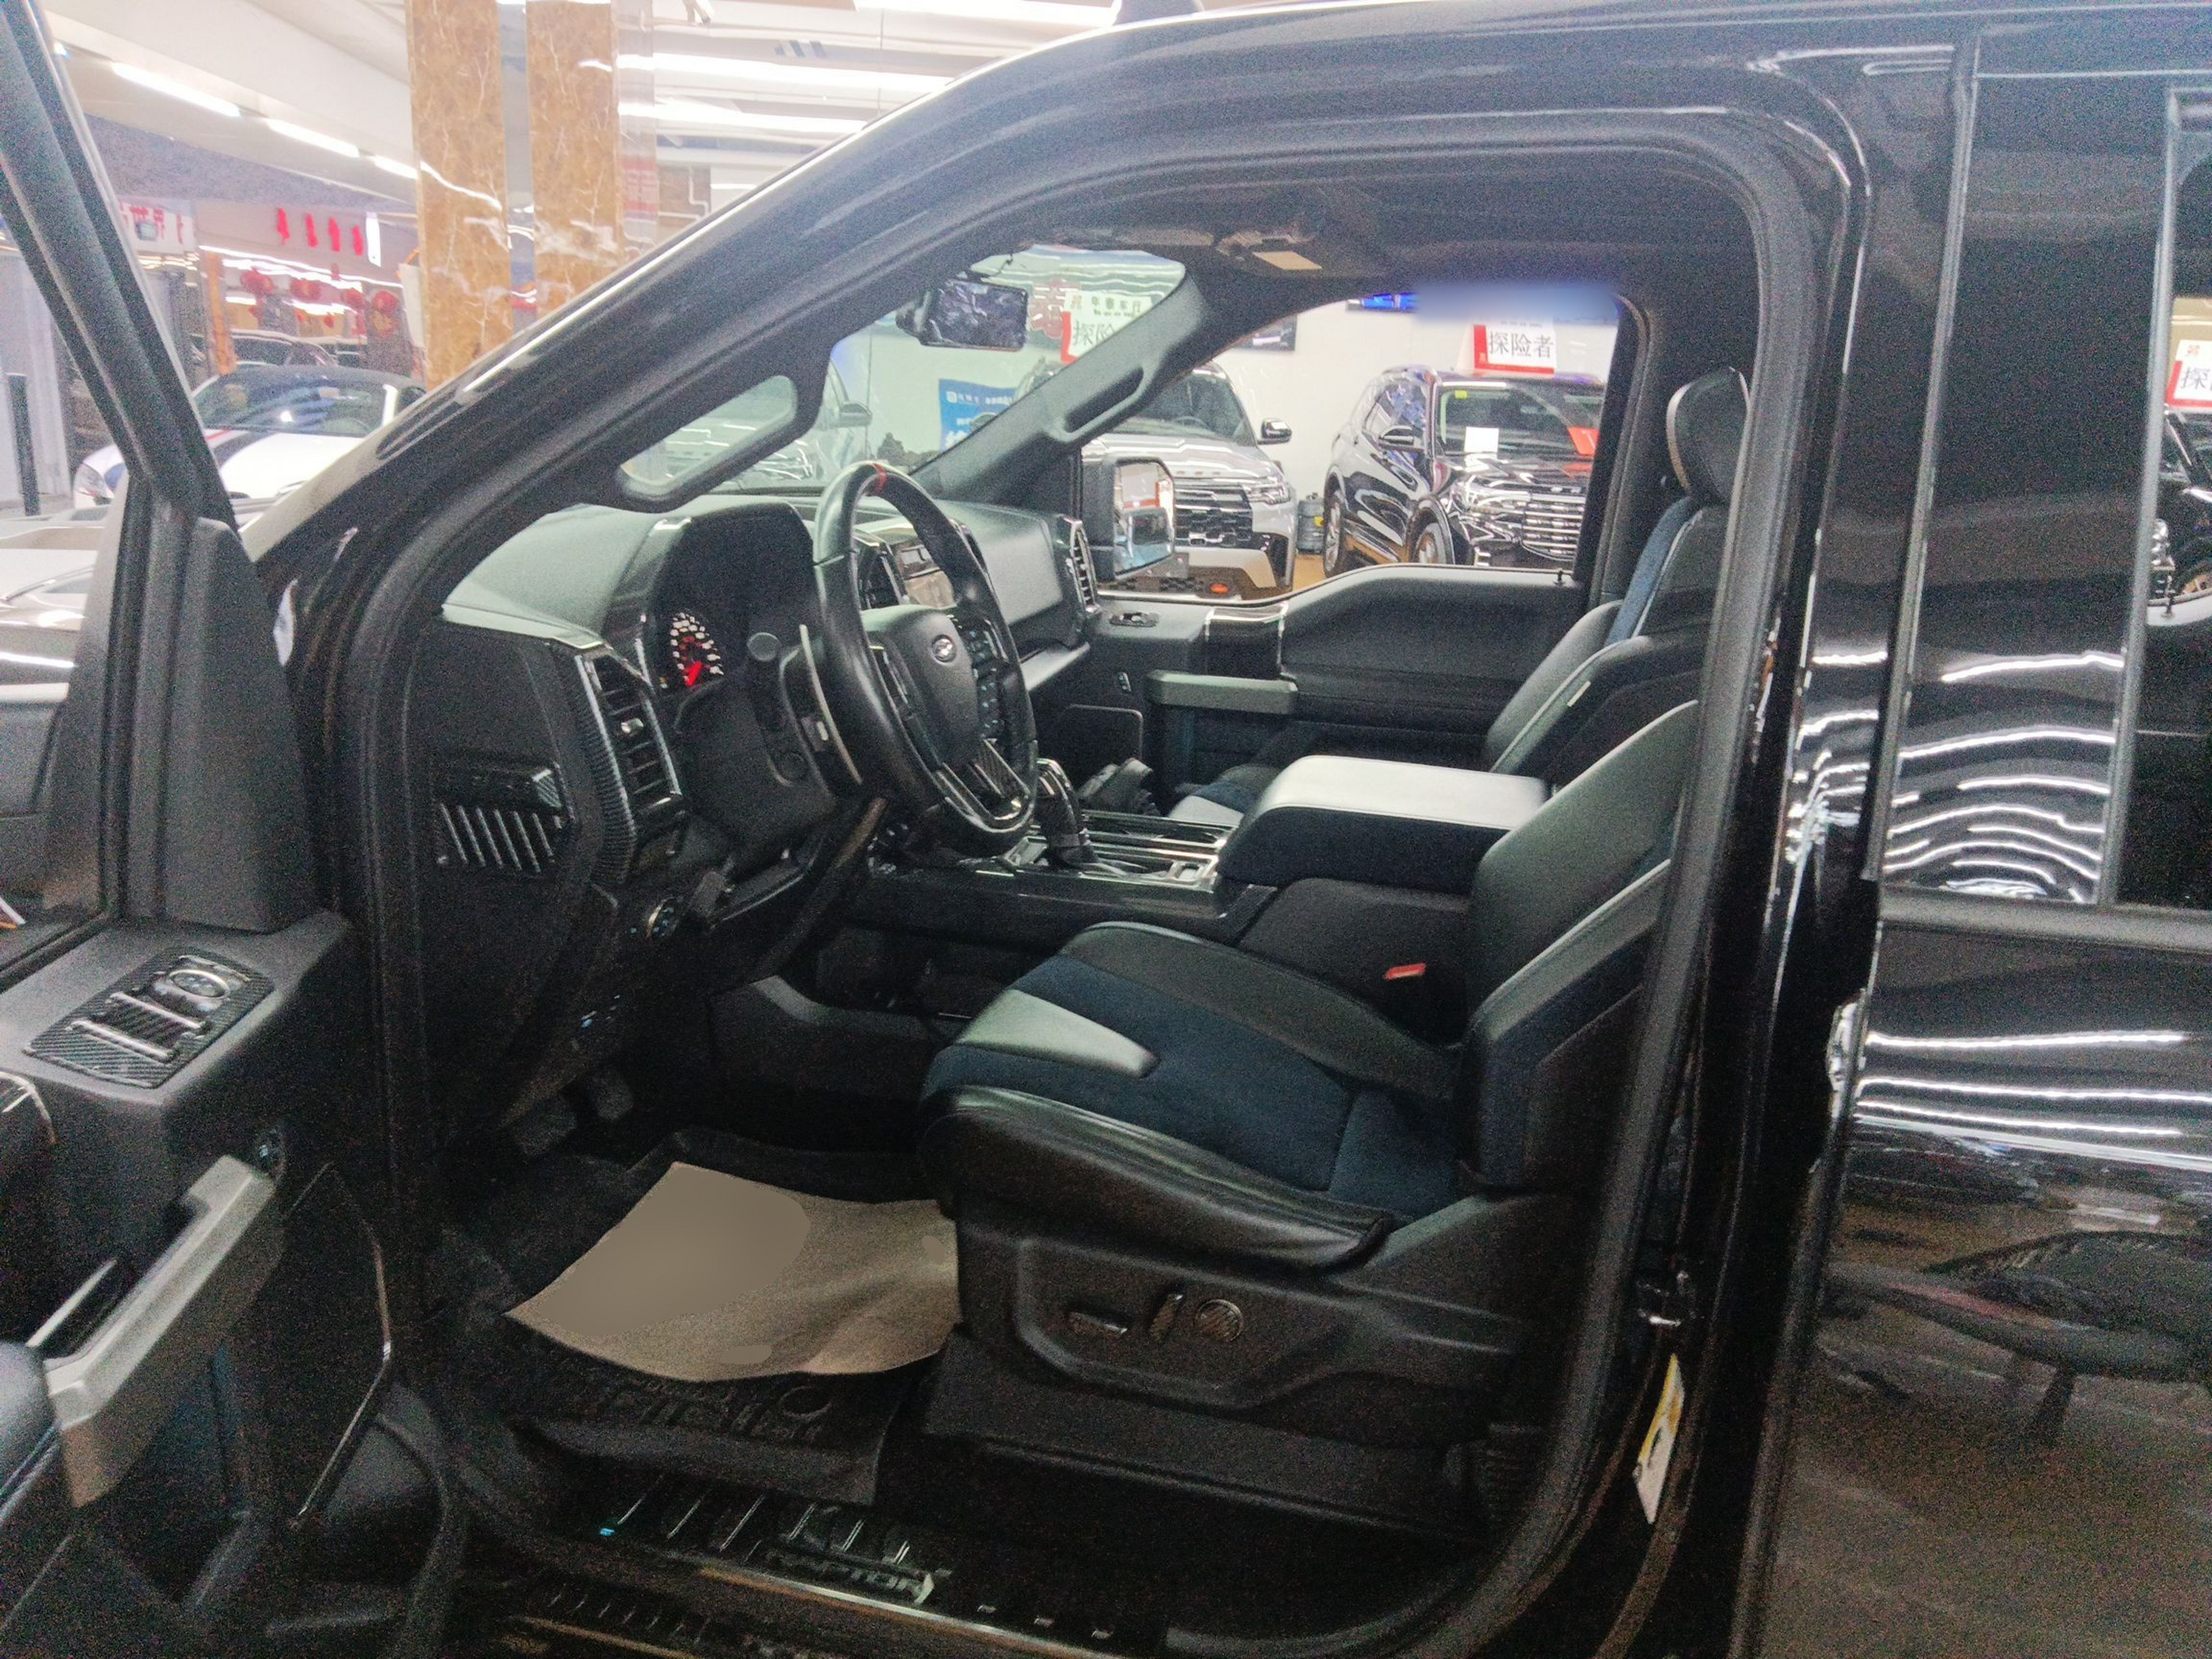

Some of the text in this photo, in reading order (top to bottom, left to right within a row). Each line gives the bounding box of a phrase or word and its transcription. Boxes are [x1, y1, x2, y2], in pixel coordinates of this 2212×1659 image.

[1488, 330, 1554, 358] 探险者
[2180, 366, 2212, 390] 探
